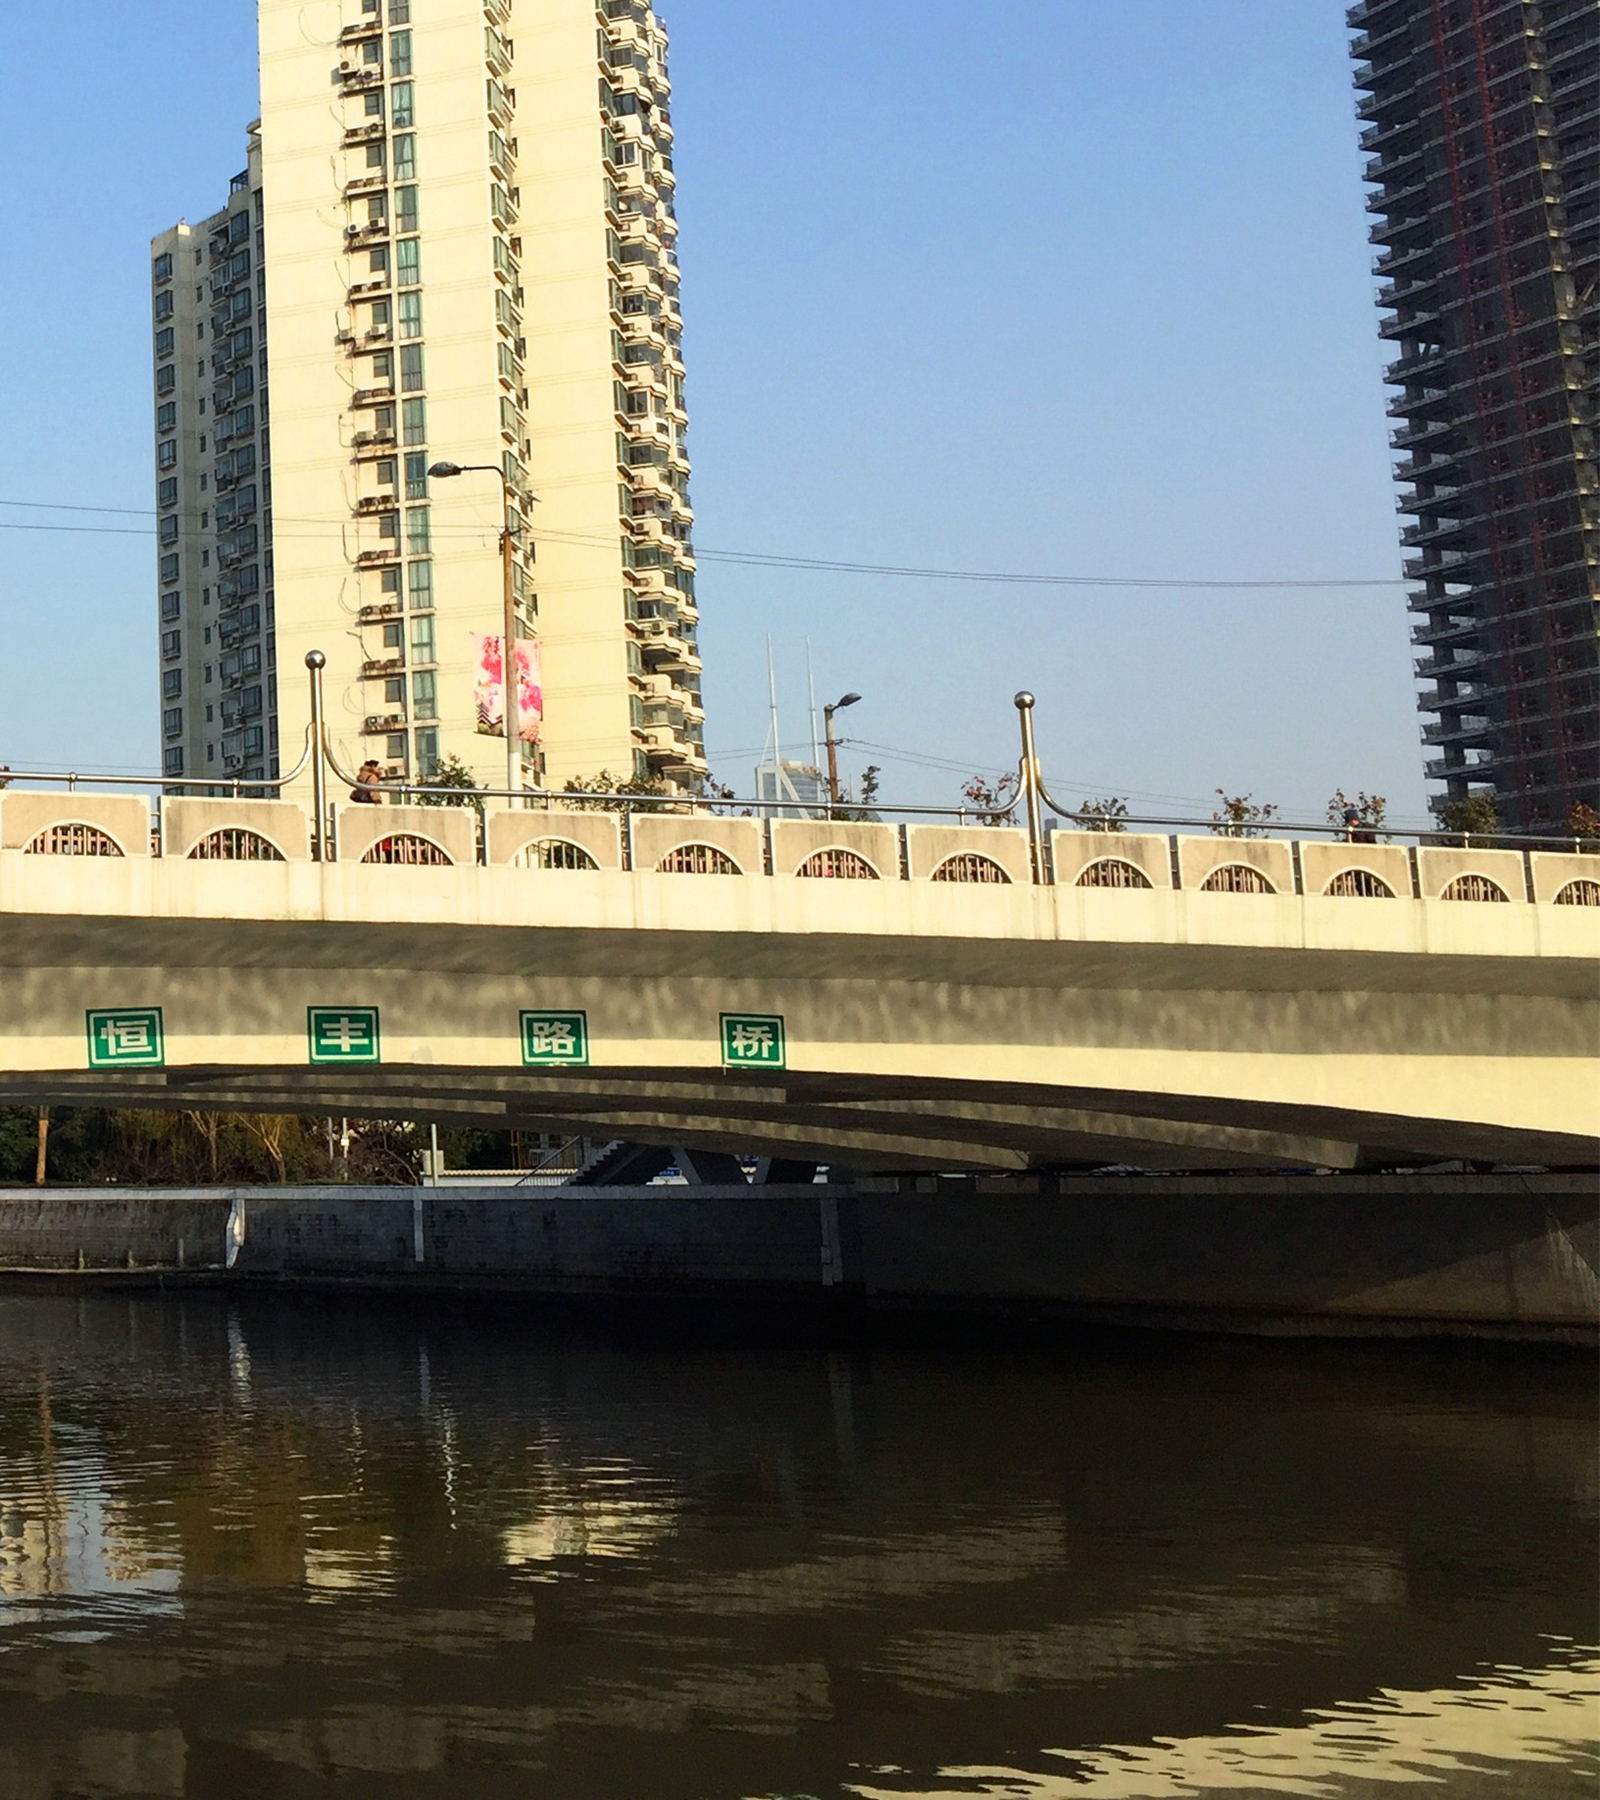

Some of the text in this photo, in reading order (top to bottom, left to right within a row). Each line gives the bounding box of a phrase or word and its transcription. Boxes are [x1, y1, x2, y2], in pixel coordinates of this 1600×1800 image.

[100, 1017, 774, 1058] 恒 丰 路 桥
